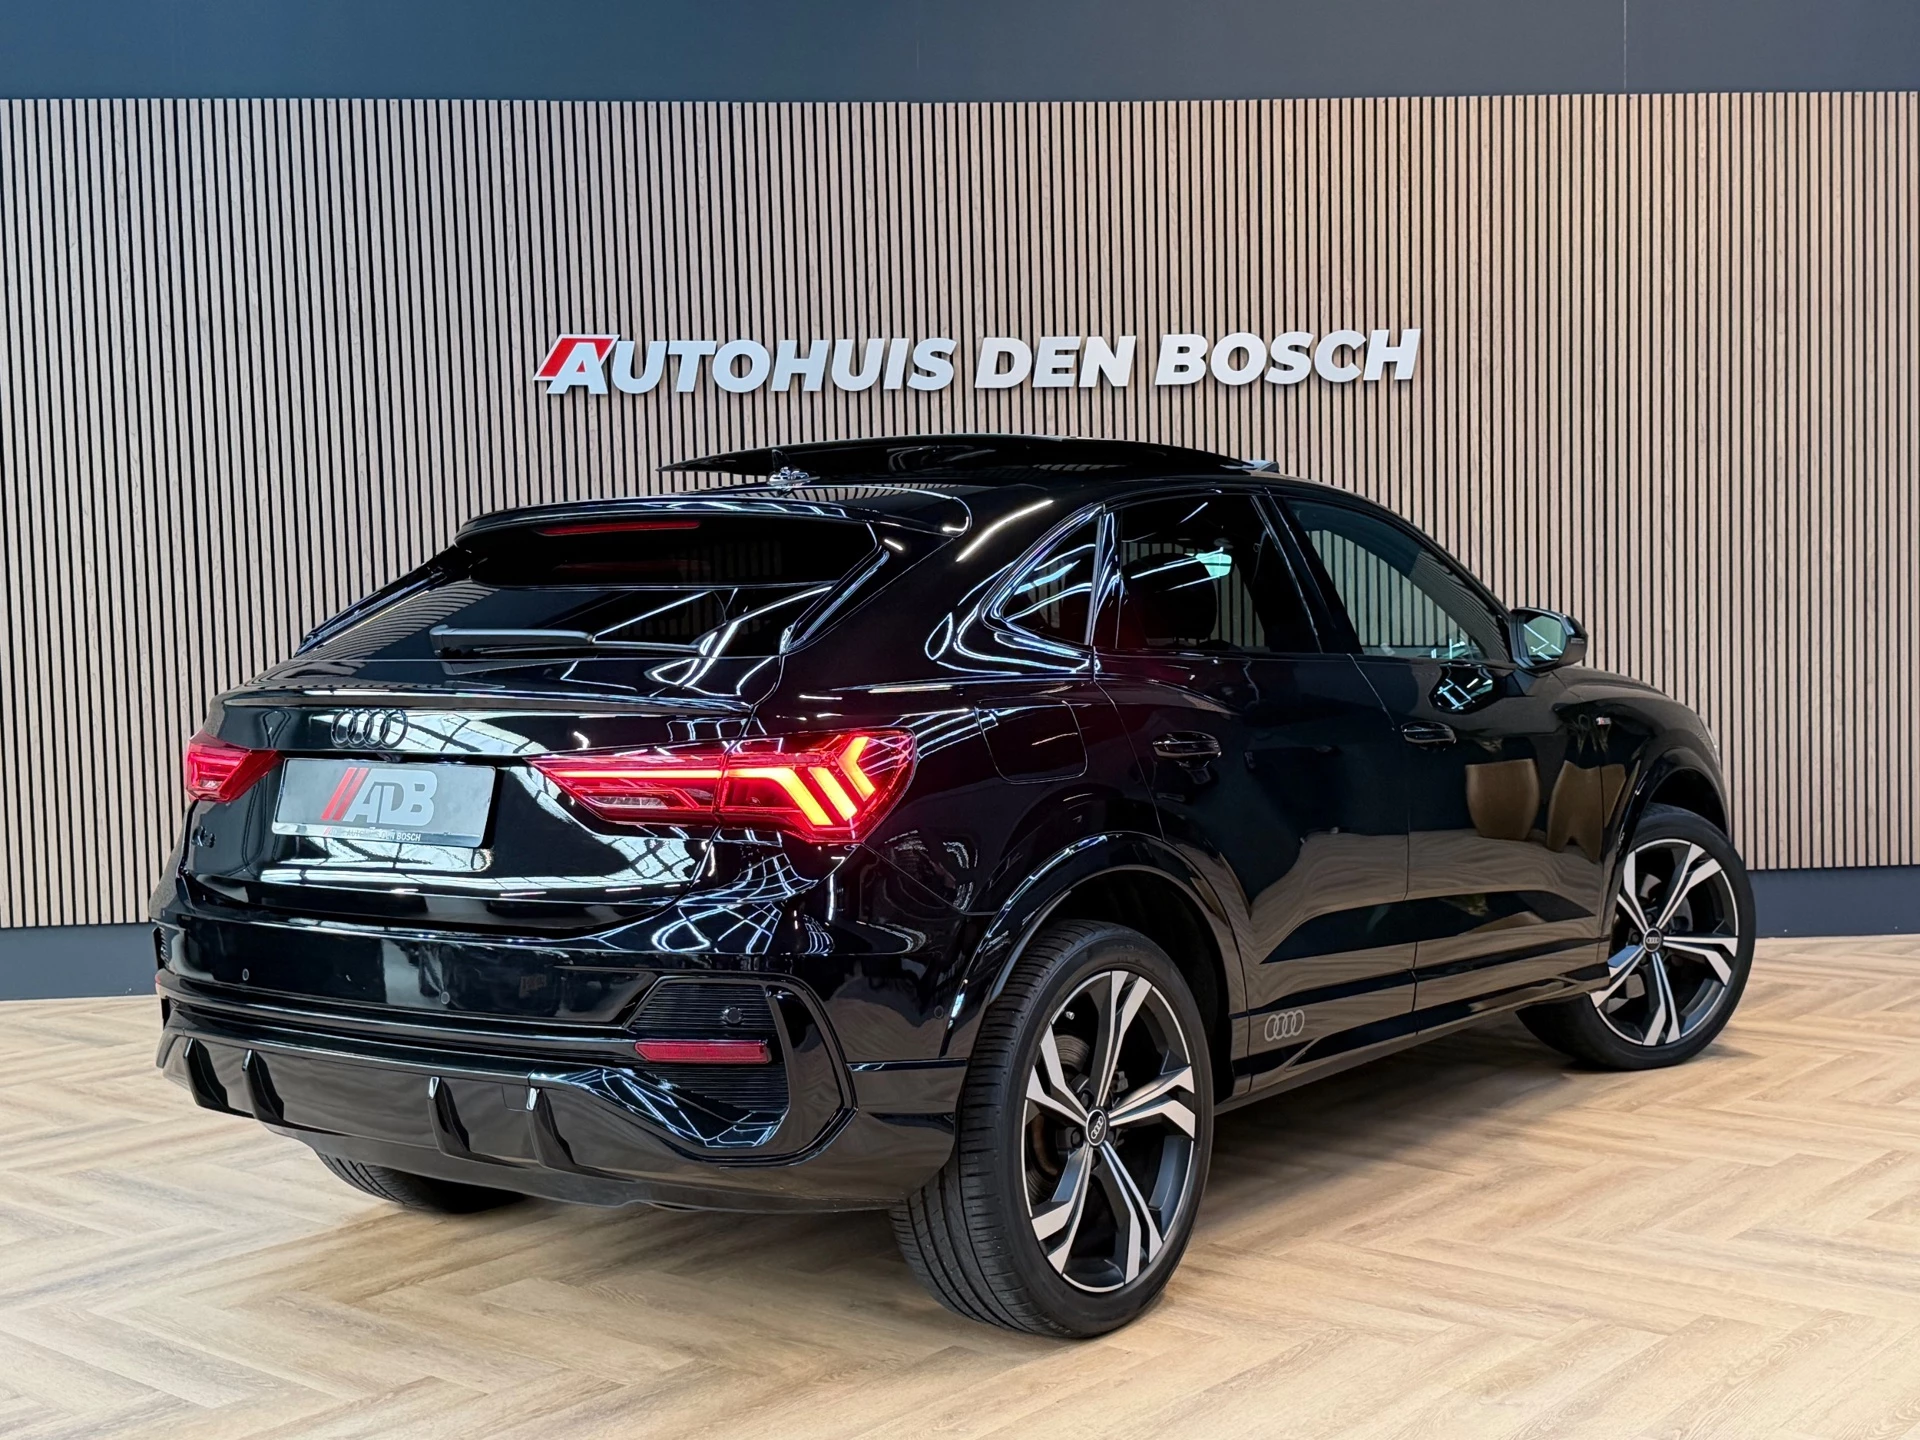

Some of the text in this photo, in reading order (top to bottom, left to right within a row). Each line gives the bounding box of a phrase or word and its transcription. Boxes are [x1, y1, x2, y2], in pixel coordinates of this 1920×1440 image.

[534, 328, 1421, 395] AUTOHUIS DEN BOSCH
[342, 768, 438, 827] ADB
[396, 832, 421, 842] BOSCH
